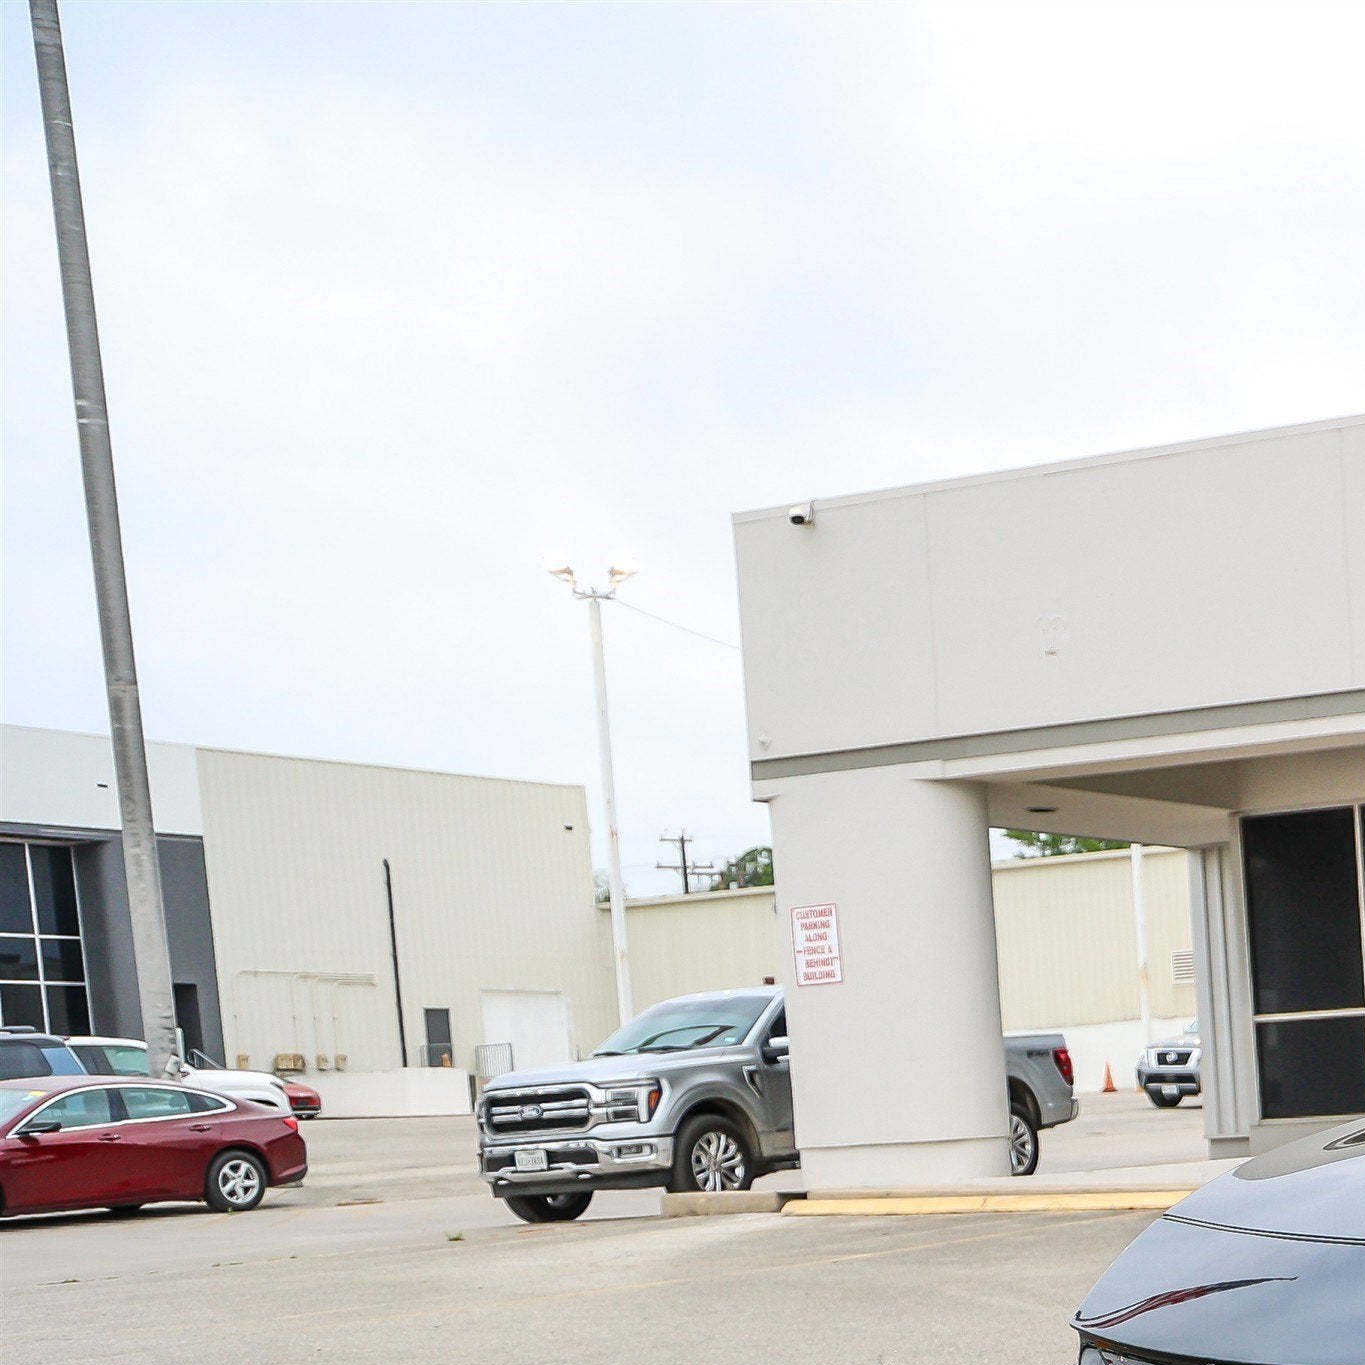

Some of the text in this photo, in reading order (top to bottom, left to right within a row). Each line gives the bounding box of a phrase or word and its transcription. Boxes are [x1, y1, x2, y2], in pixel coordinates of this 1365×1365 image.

[796, 908, 832, 920] CUSTOMER
[800, 920, 830, 931] PARKING
[805, 932, 827, 942] ALONG
[803, 946, 826, 956] FENCE
[803, 970, 836, 981] BUILDING
